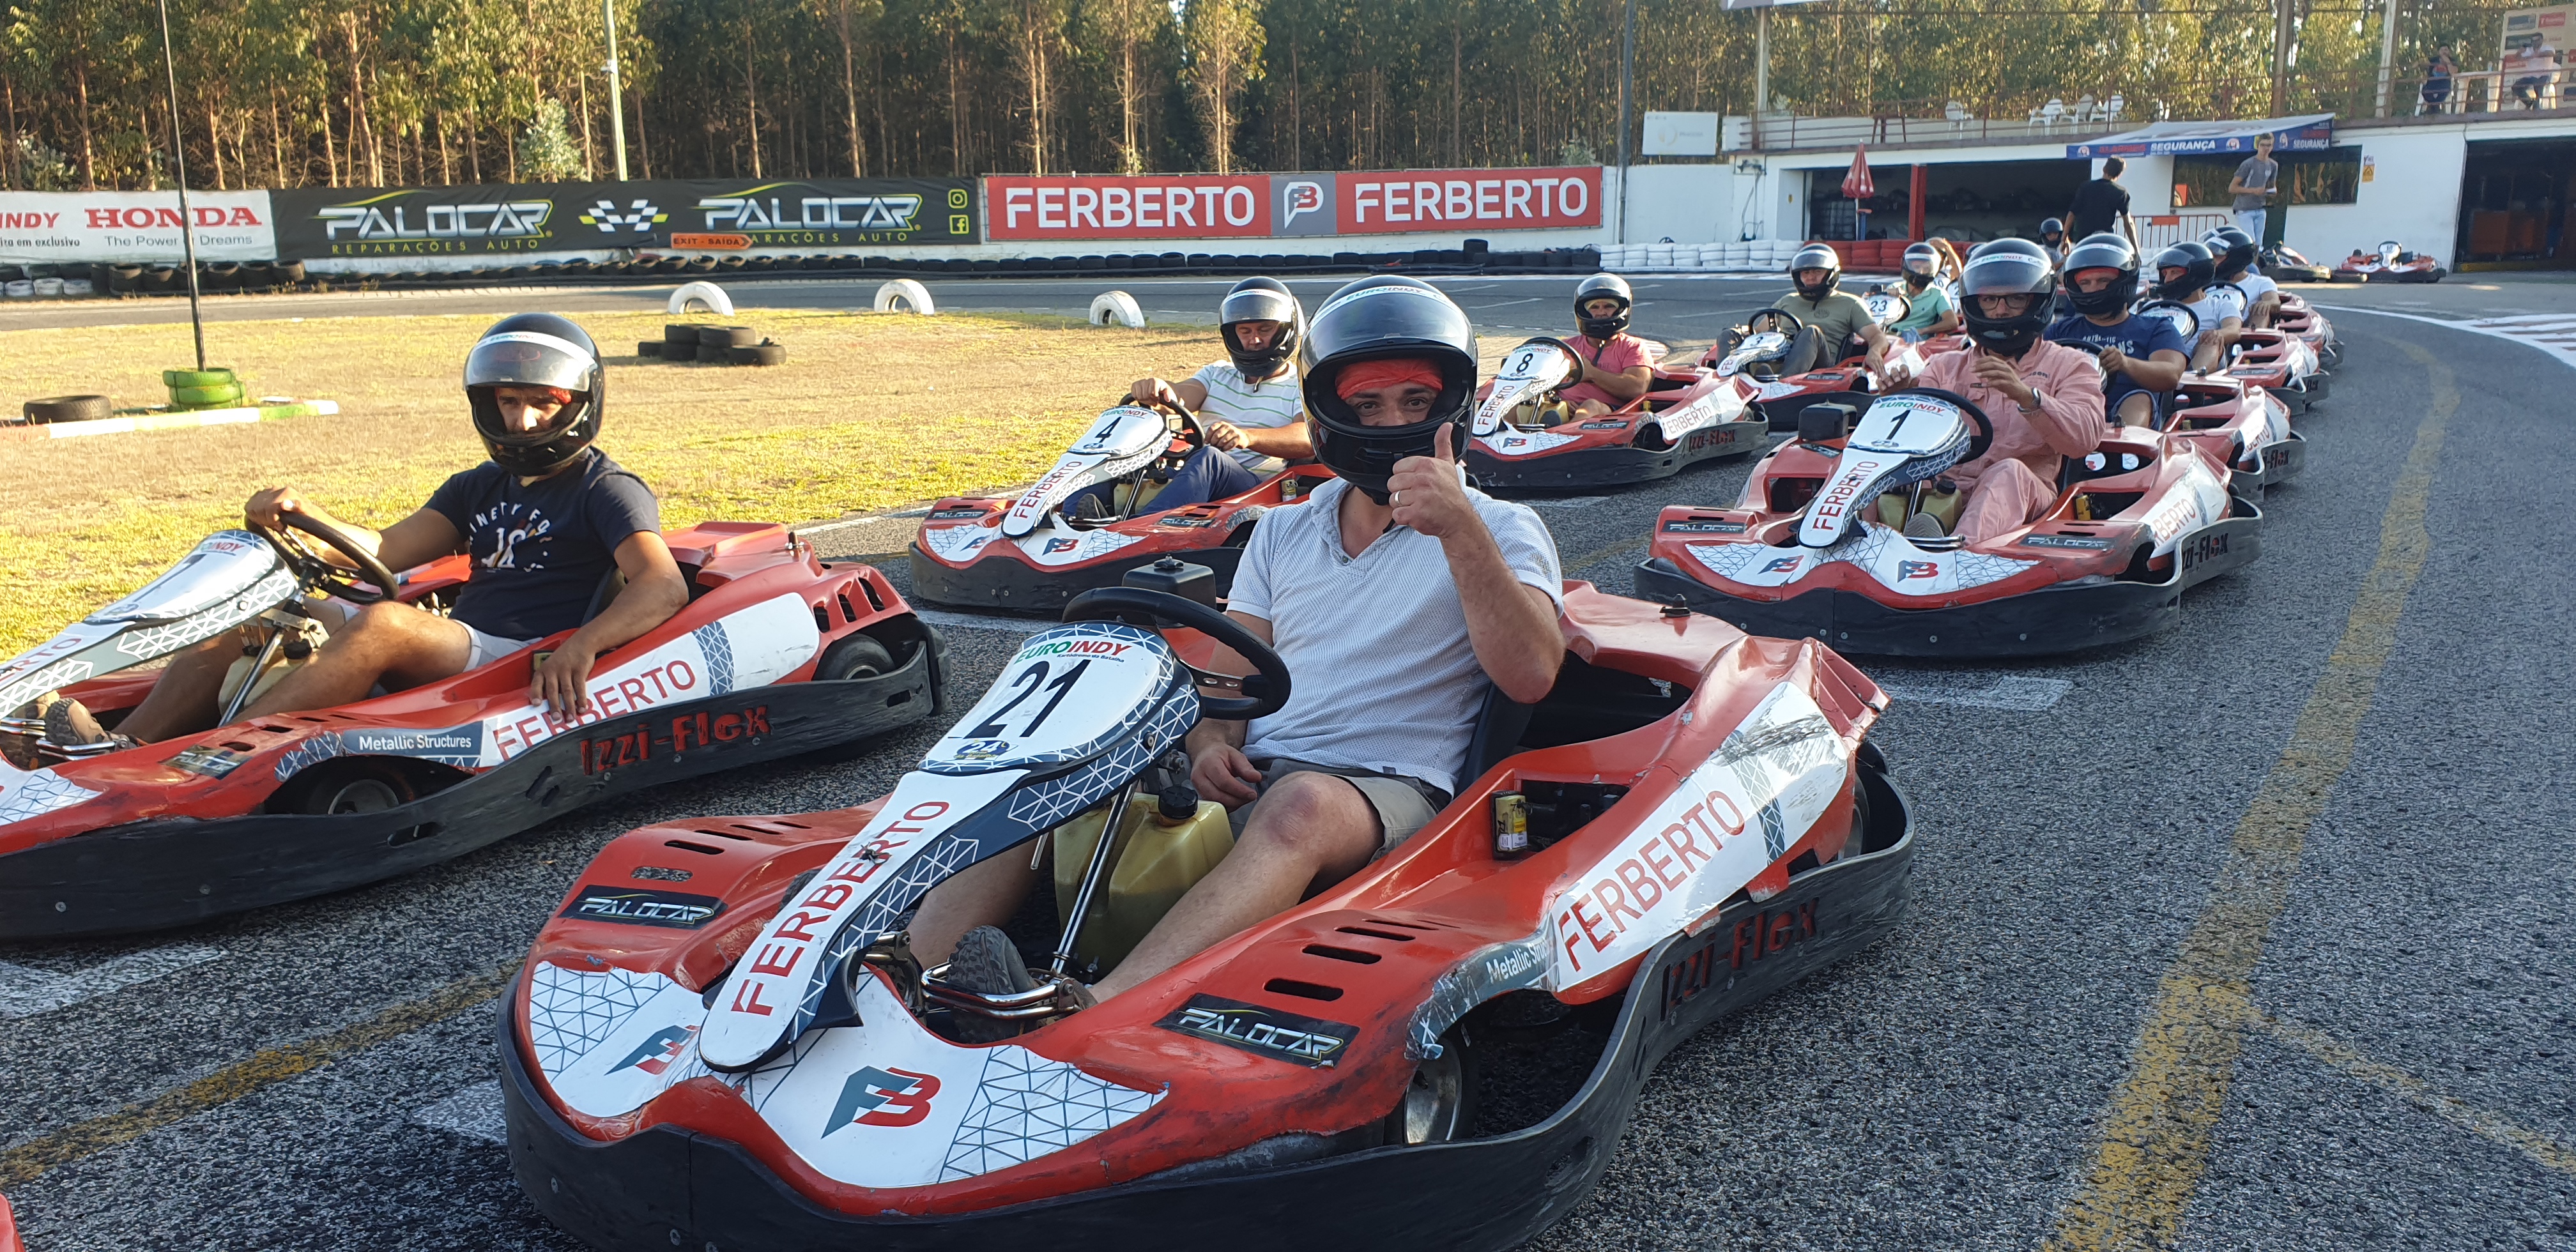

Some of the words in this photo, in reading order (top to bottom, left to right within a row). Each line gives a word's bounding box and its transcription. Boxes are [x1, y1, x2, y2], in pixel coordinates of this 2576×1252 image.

[2150, 140, 2215, 152] SEGURANÇA
[1006, 185, 1255, 229] FERBERTO
[1355, 177, 1587, 222] FERBERTO
[84, 207, 263, 228] HONDA
[319, 203, 549, 240] PALOCAR
[699, 197, 918, 230] PALOCAR
[36, 236, 80, 247] exclusivo
[105, 235, 131, 247] The
[136, 235, 178, 247] Power
[200, 234, 252, 246] Dreams
[486, 239, 537, 250] AUTO
[708, 237, 740, 245] SAÍDA
[751, 232, 839, 244] ARAÇÕES
[859, 232, 907, 242] AUTO
[1346, 287, 1423, 300] EUROINDY
[1869, 300, 1887, 312] 23
[1750, 336, 1763, 347] 3
[1516, 353, 1533, 374] 8
[1477, 385, 1515, 426] FERBERTO
[1878, 402, 1945, 414] EUROINDY
[1094, 416, 1122, 443] 4
[1663, 405, 1712, 436] ERBERTO
[1890, 409, 1910, 440] 1
[1014, 461, 1082, 519] FERBERTO
[1813, 462, 1879, 530] FERBERTO
[1669, 523, 1742, 532] PALOCAR
[1014, 641, 1132, 664] EUROINDY
[1101, 655, 1124, 663] Batalha
[963, 659, 1091, 739] 21
[359, 735, 415, 751] Metallic
[417, 735, 471, 749] Structures
[962, 741, 1002, 753] 24
[1558, 790, 1745, 972] FERBERTO
[579, 897, 714, 924] PALOCAR
[732, 801, 950, 1016] FERBERTO
[1485, 948, 1531, 984] Metallic
[1180, 1008, 1343, 1060] PALOCAR
